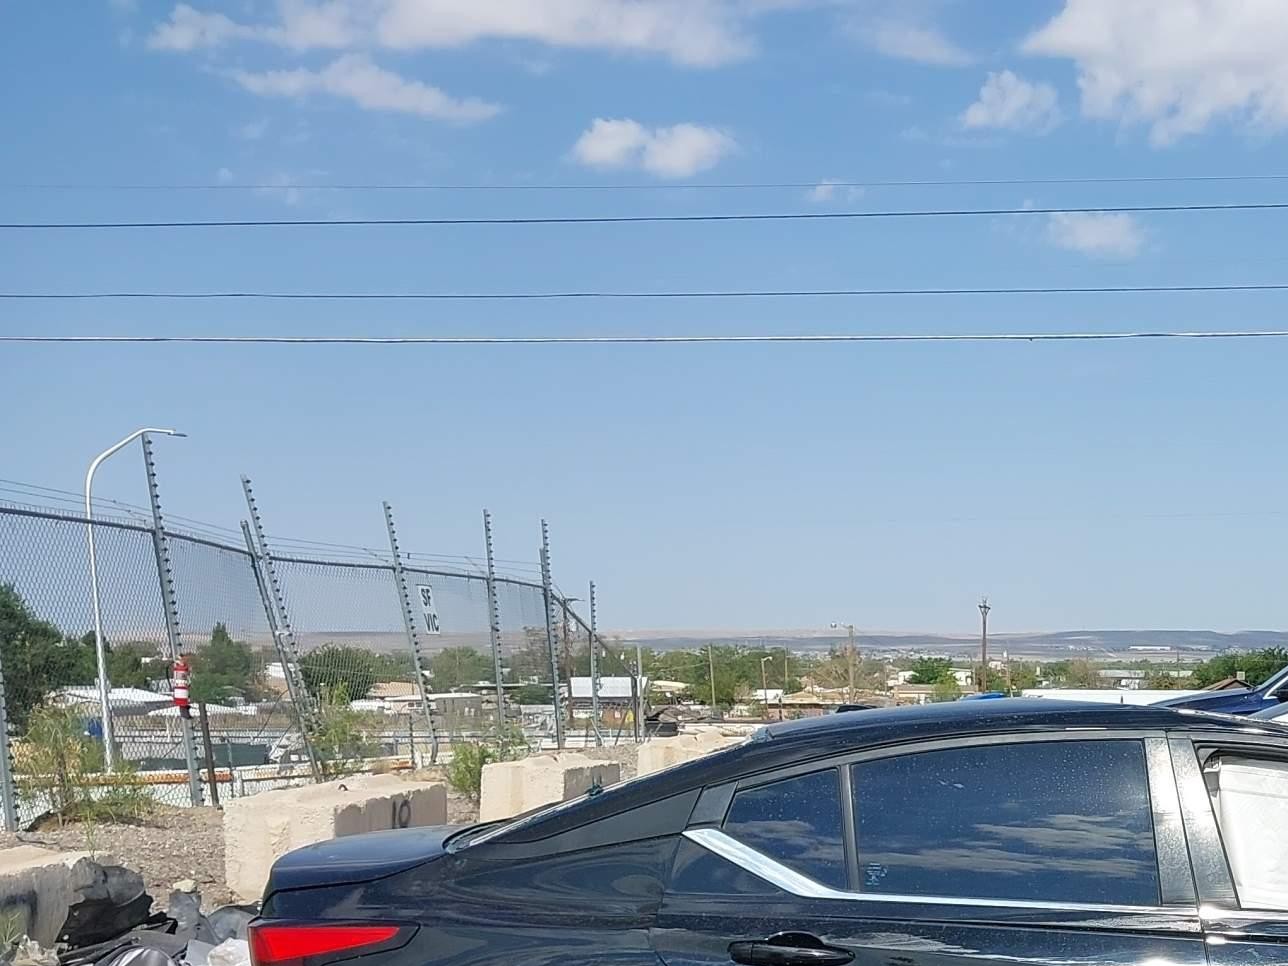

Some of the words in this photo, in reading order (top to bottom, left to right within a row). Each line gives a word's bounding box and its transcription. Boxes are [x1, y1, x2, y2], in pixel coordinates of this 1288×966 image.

[420, 588, 431, 607] SF
[423, 612, 439, 632] VIC
[391, 800, 411, 830] 10
